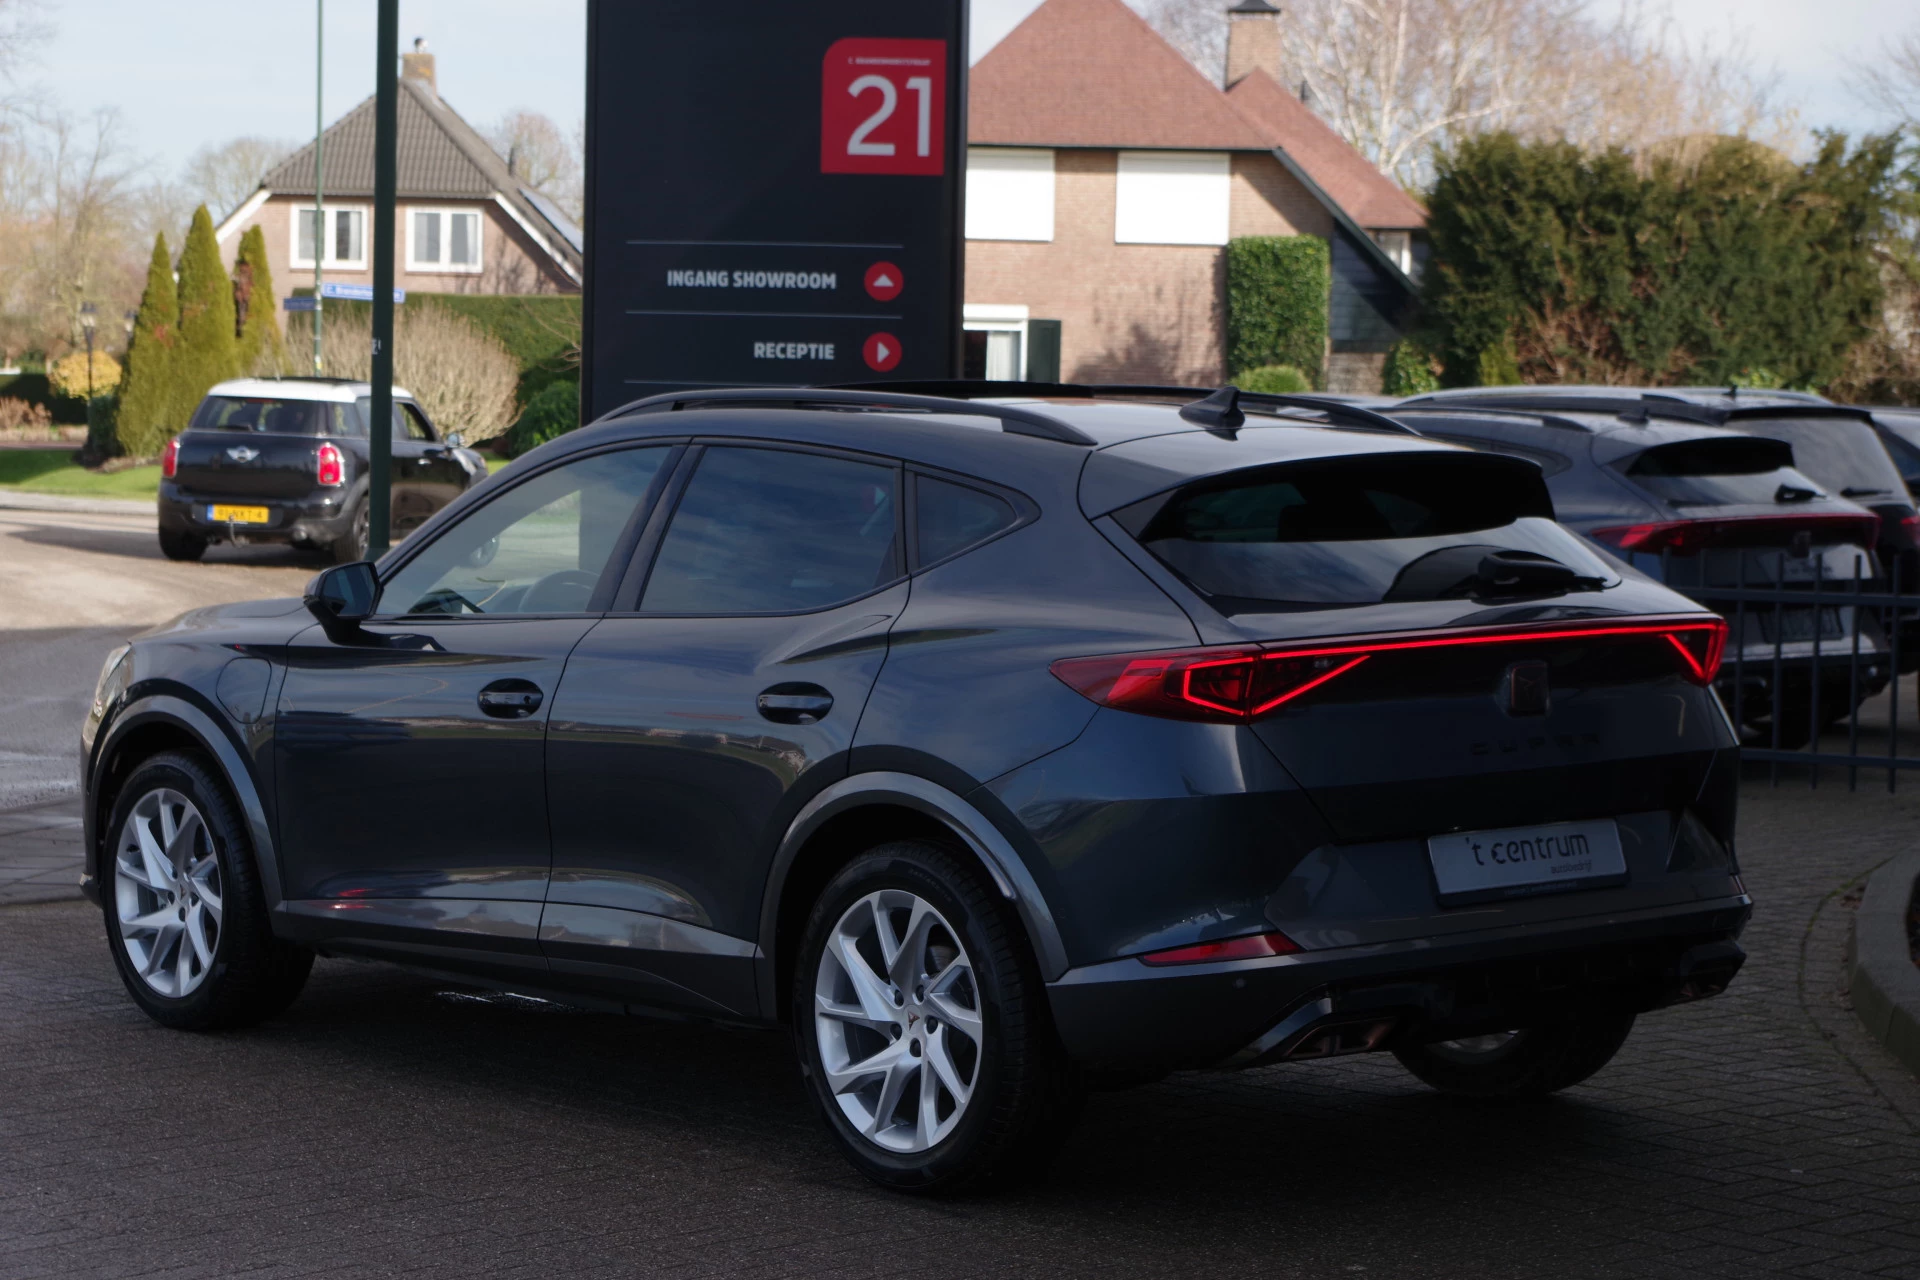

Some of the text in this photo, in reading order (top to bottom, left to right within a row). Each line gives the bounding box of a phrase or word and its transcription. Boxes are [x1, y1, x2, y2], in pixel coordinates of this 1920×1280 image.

[846, 74, 932, 157] 21
[666, 270, 837, 289] INGANG SHOWROOM
[753, 342, 835, 360] RECEPTIE
[1465, 833, 1590, 866] 't centrum
